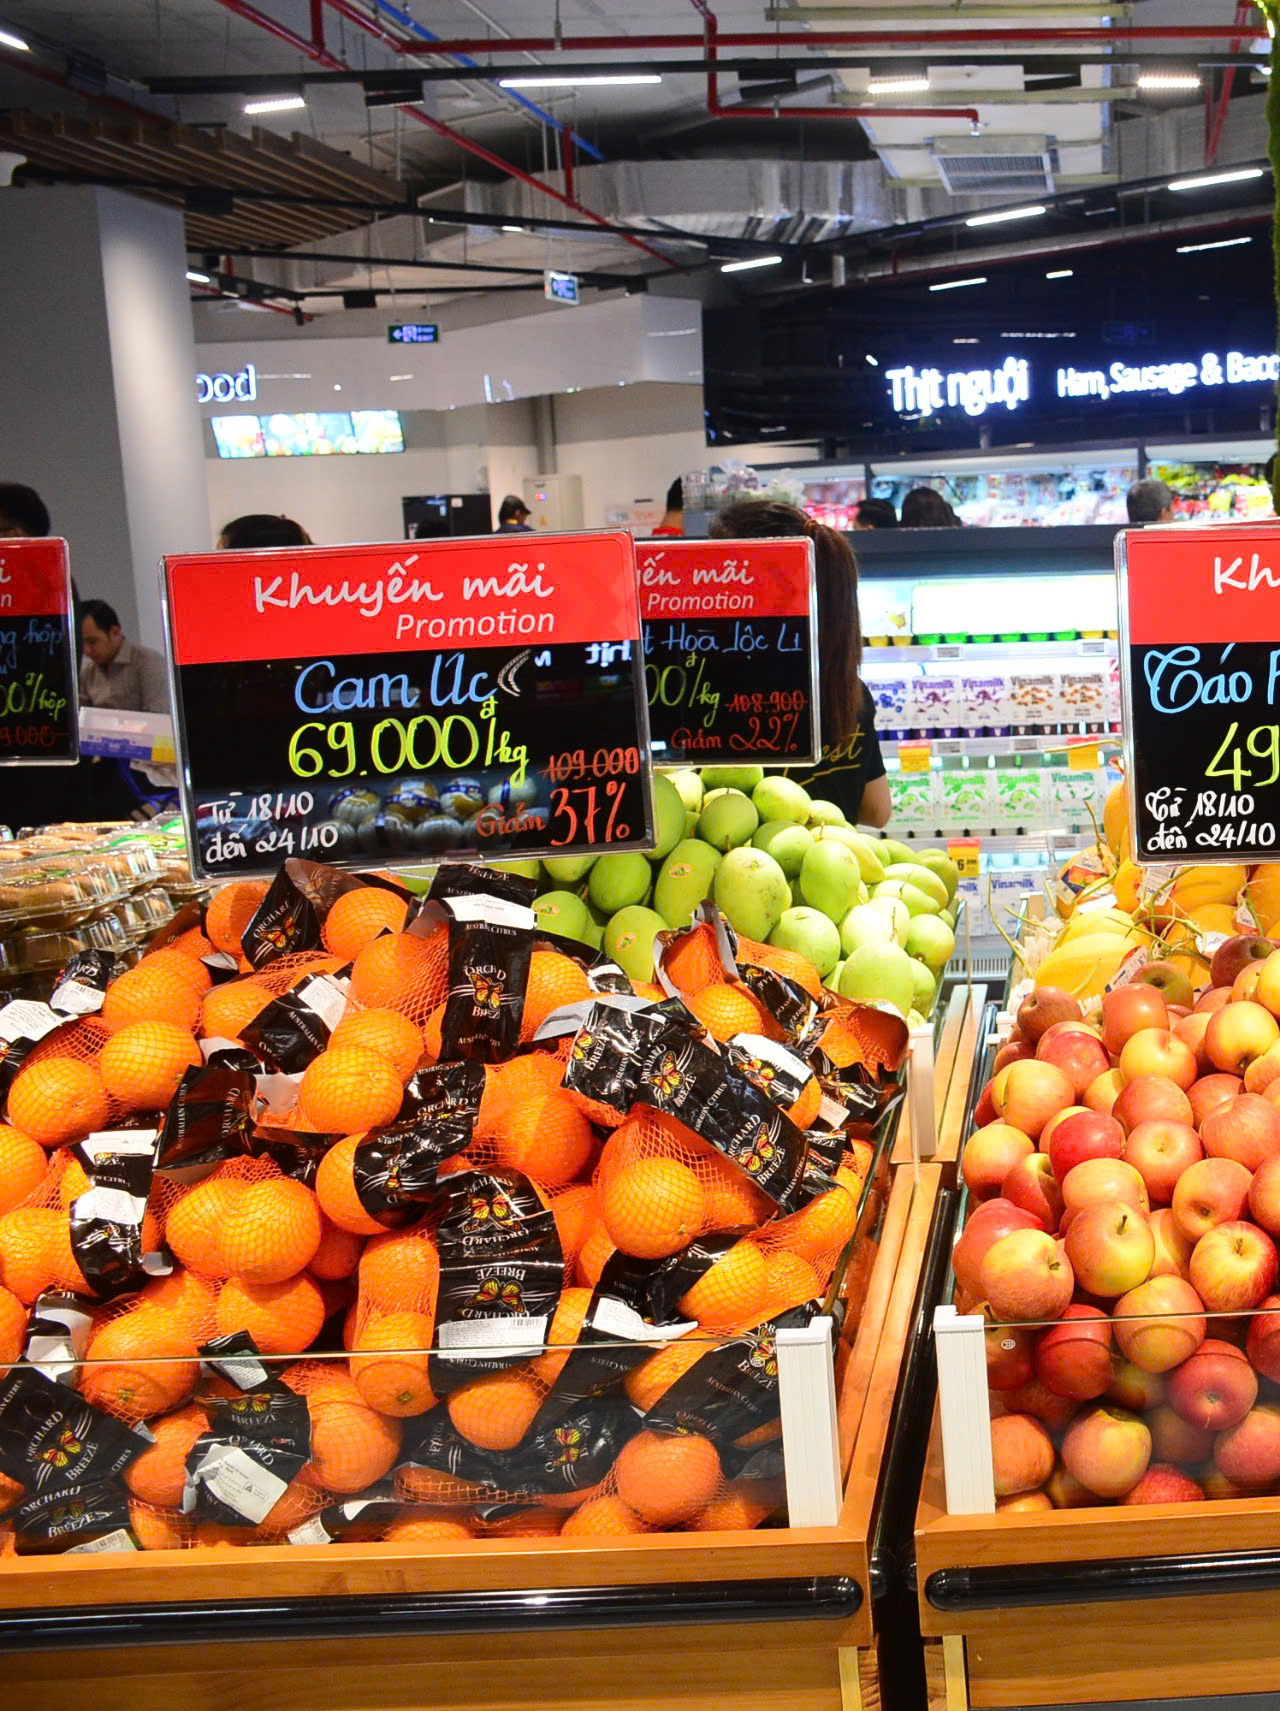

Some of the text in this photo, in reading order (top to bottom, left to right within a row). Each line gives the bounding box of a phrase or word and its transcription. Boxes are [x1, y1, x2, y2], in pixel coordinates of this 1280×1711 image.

[1200, 351, 1224, 385] &
[885, 356, 1030, 416] Thịt nguội
[254, 553, 554, 617] Khuyến mãi
[692, 561, 755, 585] mãi
[647, 593, 755, 612] Promotion
[396, 608, 555, 639] Promotion
[295, 660, 420, 714] Cam
[912, 679, 955, 690] Vinamilk
[962, 678, 1005, 689] Vinamilk
[1011, 676, 1053, 687] Vinamilk
[1060, 674, 1104, 685] Vinamilk
[1144, 642, 1253, 714] Táo
[729, 713, 799, 752] 22%
[1051, 772, 1095, 783] Vinamilk
[209, 789, 314, 825] Từ 18/10
[476, 781, 631, 846] Giảm 37%
[1145, 786, 1255, 822] Từ 18/10
[205, 823, 338, 864] đến 24/10
[1147, 817, 1277, 850] đến 24/10
[707, 1082, 728, 1107] CITRUS
[756, 1145, 787, 1186] BREEZE
[475, 1267, 527, 1282] BREEZE
[26, 1411, 64, 1463] ORCHARD
[65, 1440, 99, 1481] BREEZE
[20, 1486, 81, 1515] ORCHARD
